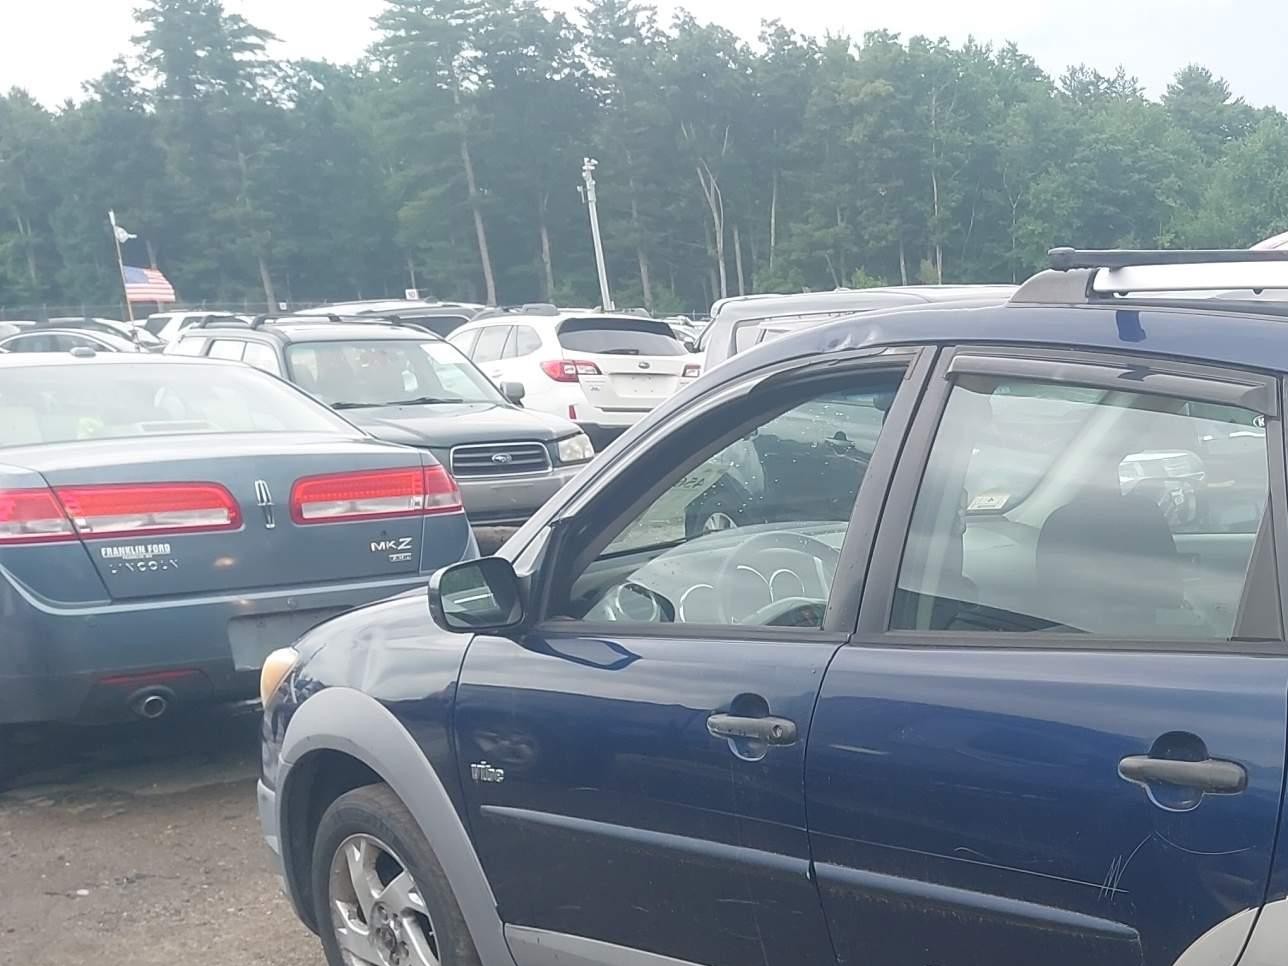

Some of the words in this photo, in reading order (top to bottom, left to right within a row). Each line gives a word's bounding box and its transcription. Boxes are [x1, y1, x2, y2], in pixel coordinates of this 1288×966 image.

[101, 545, 145, 558] FRANKLIN
[147, 543, 171, 555] FORD
[370, 537, 413, 552] MKZ
